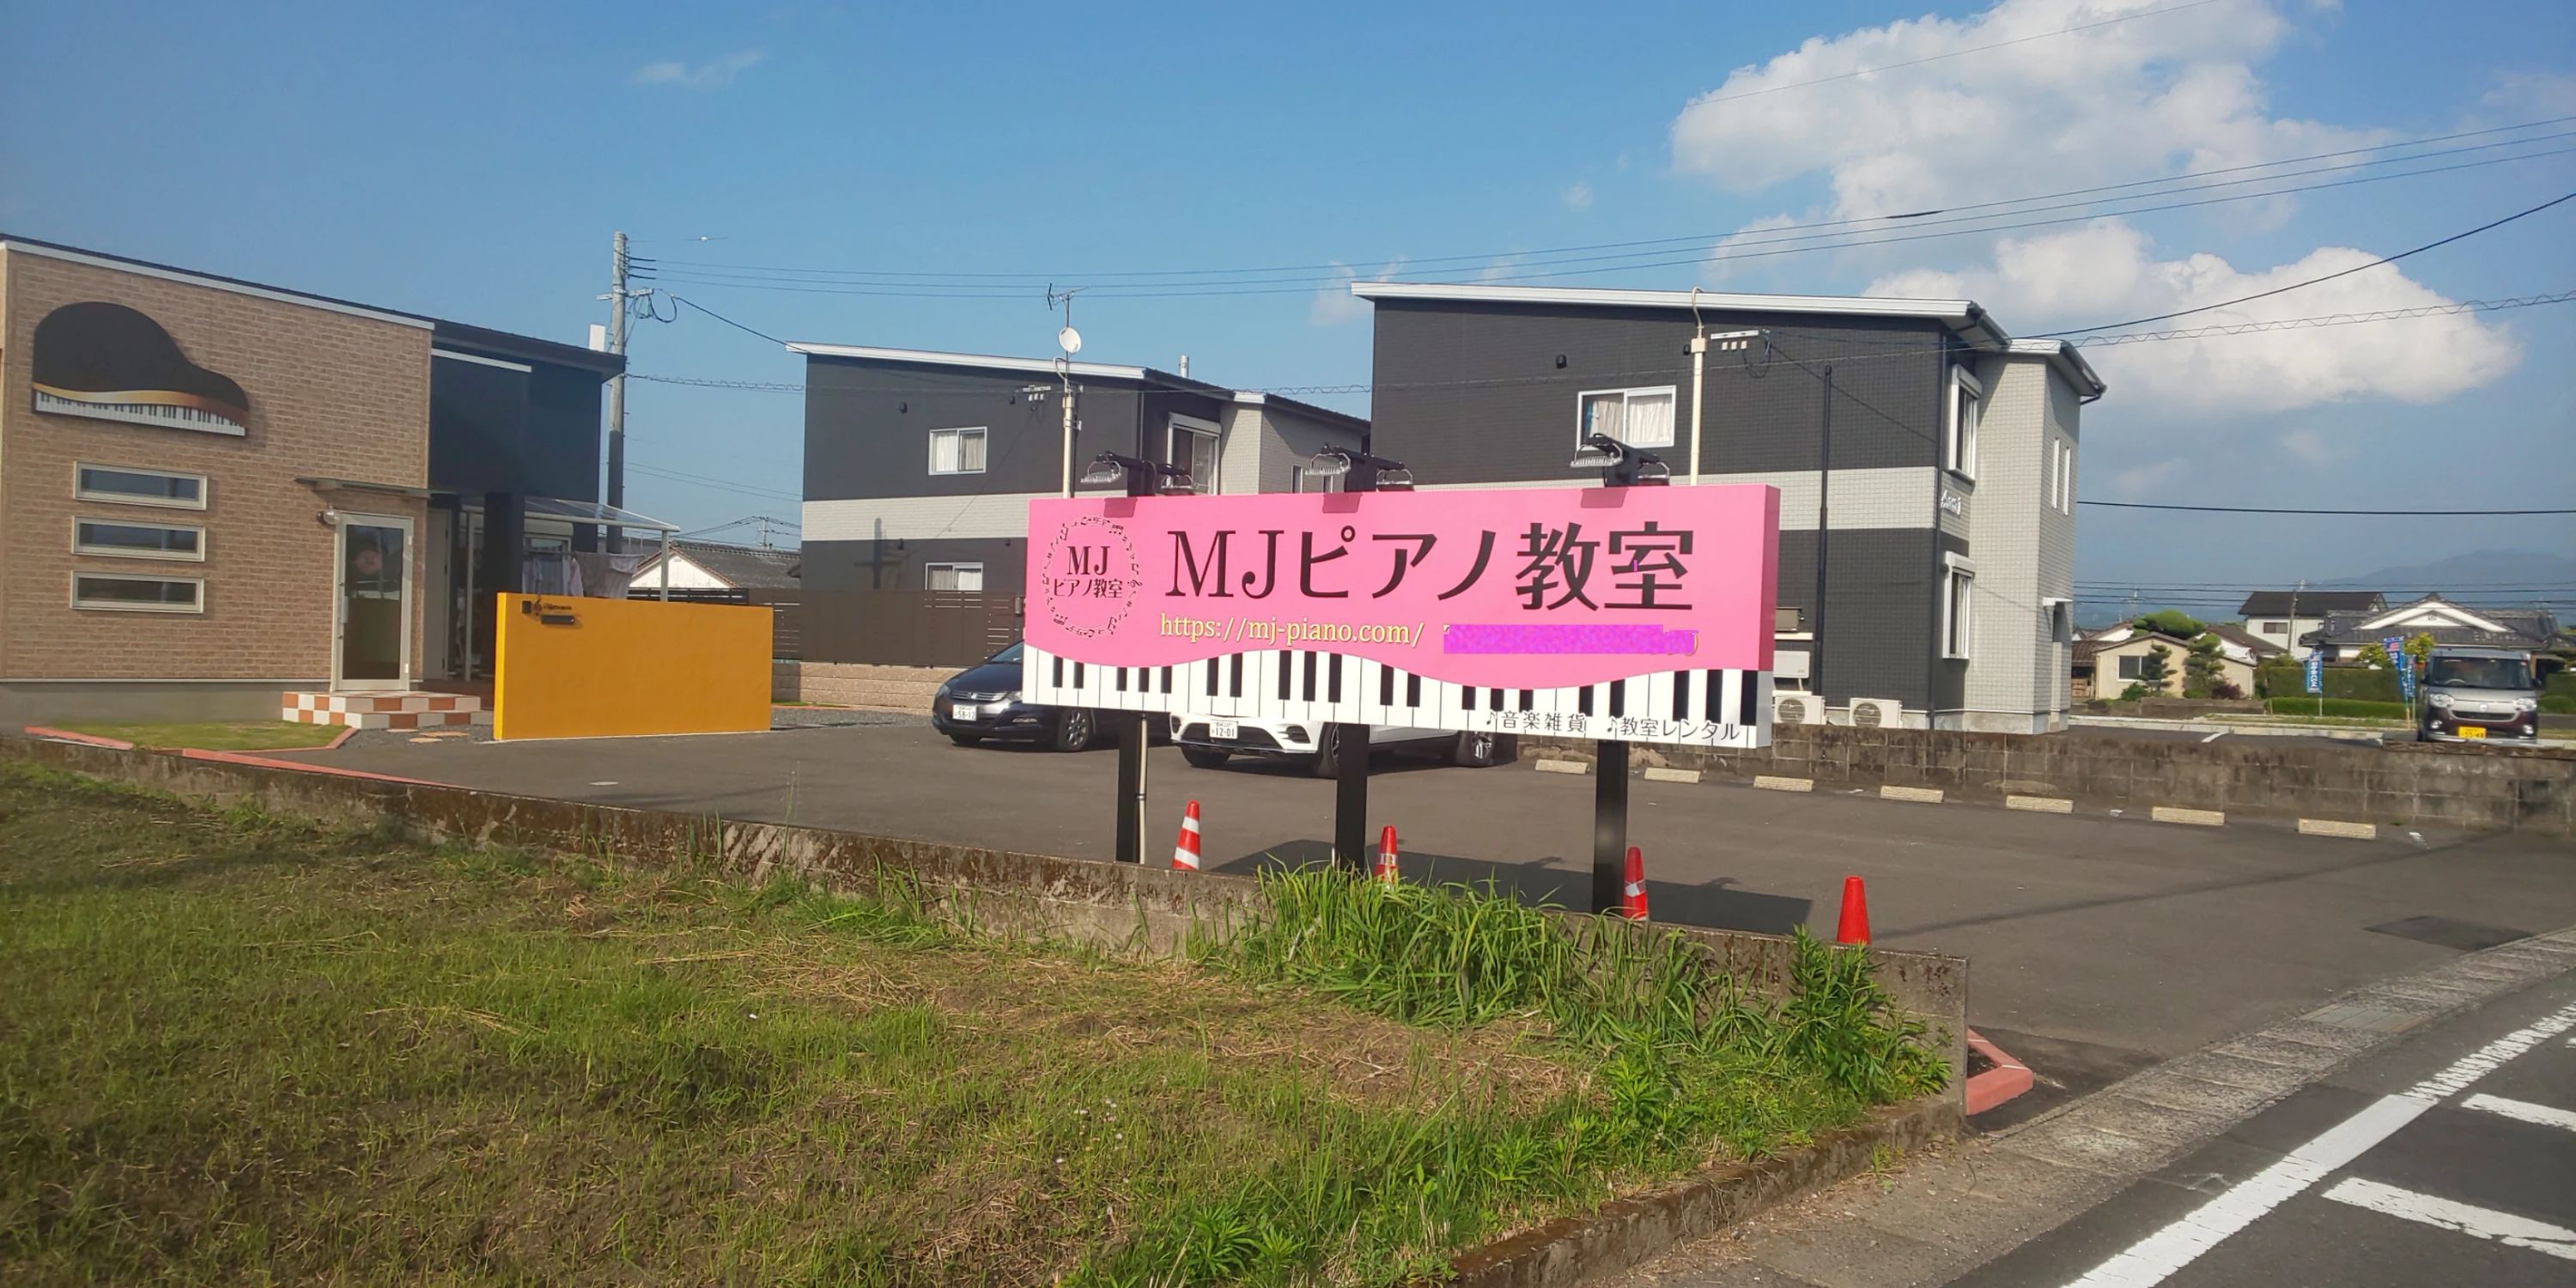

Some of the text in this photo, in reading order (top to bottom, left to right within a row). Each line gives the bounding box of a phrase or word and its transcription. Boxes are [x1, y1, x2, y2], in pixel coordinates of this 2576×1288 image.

[1066, 545, 1110, 575] MJ
[1165, 521, 1694, 611] MJピアノ教室
[1054, 578, 1123, 598] ピアノ教室
[1160, 612, 1425, 647] https://mj-piano.com/
